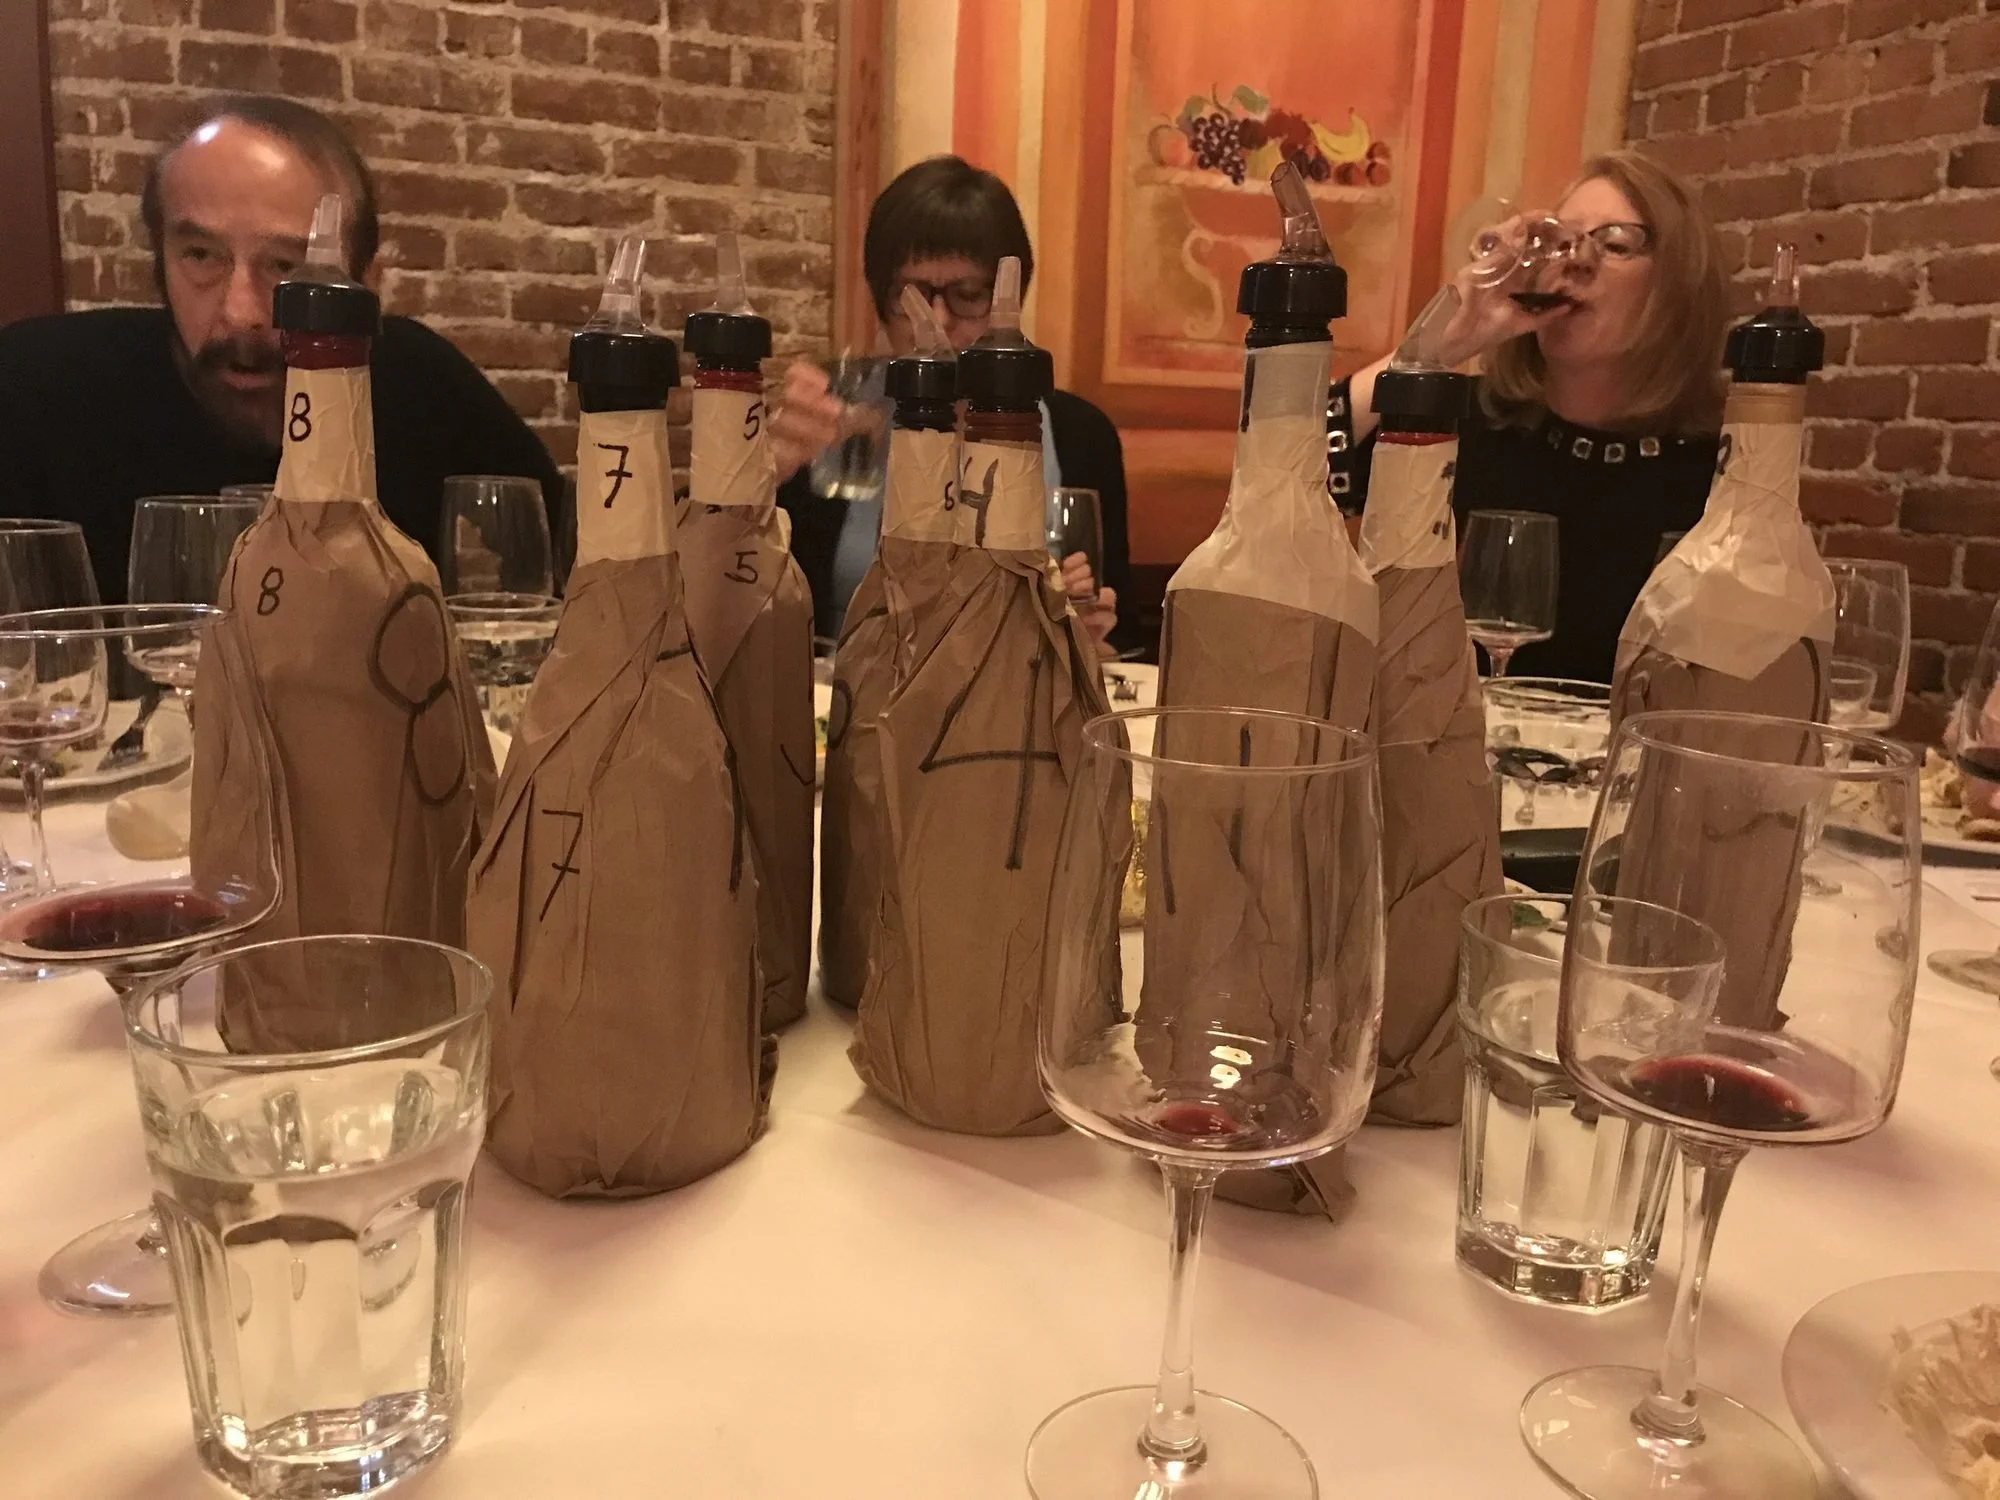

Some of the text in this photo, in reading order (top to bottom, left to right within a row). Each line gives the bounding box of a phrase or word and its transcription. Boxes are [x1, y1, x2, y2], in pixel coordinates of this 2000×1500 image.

[288, 392, 312, 442] 8
[743, 400, 764, 441] 5
[593, 443, 633, 509] 7
[944, 480, 956, 512] 6
[960, 456, 999, 549] 4
[257, 566, 284, 616] 8
[724, 550, 759, 585] 5
[370, 582, 468, 805] 8
[917, 655, 1062, 871] 4
[540, 808, 584, 922] 7
